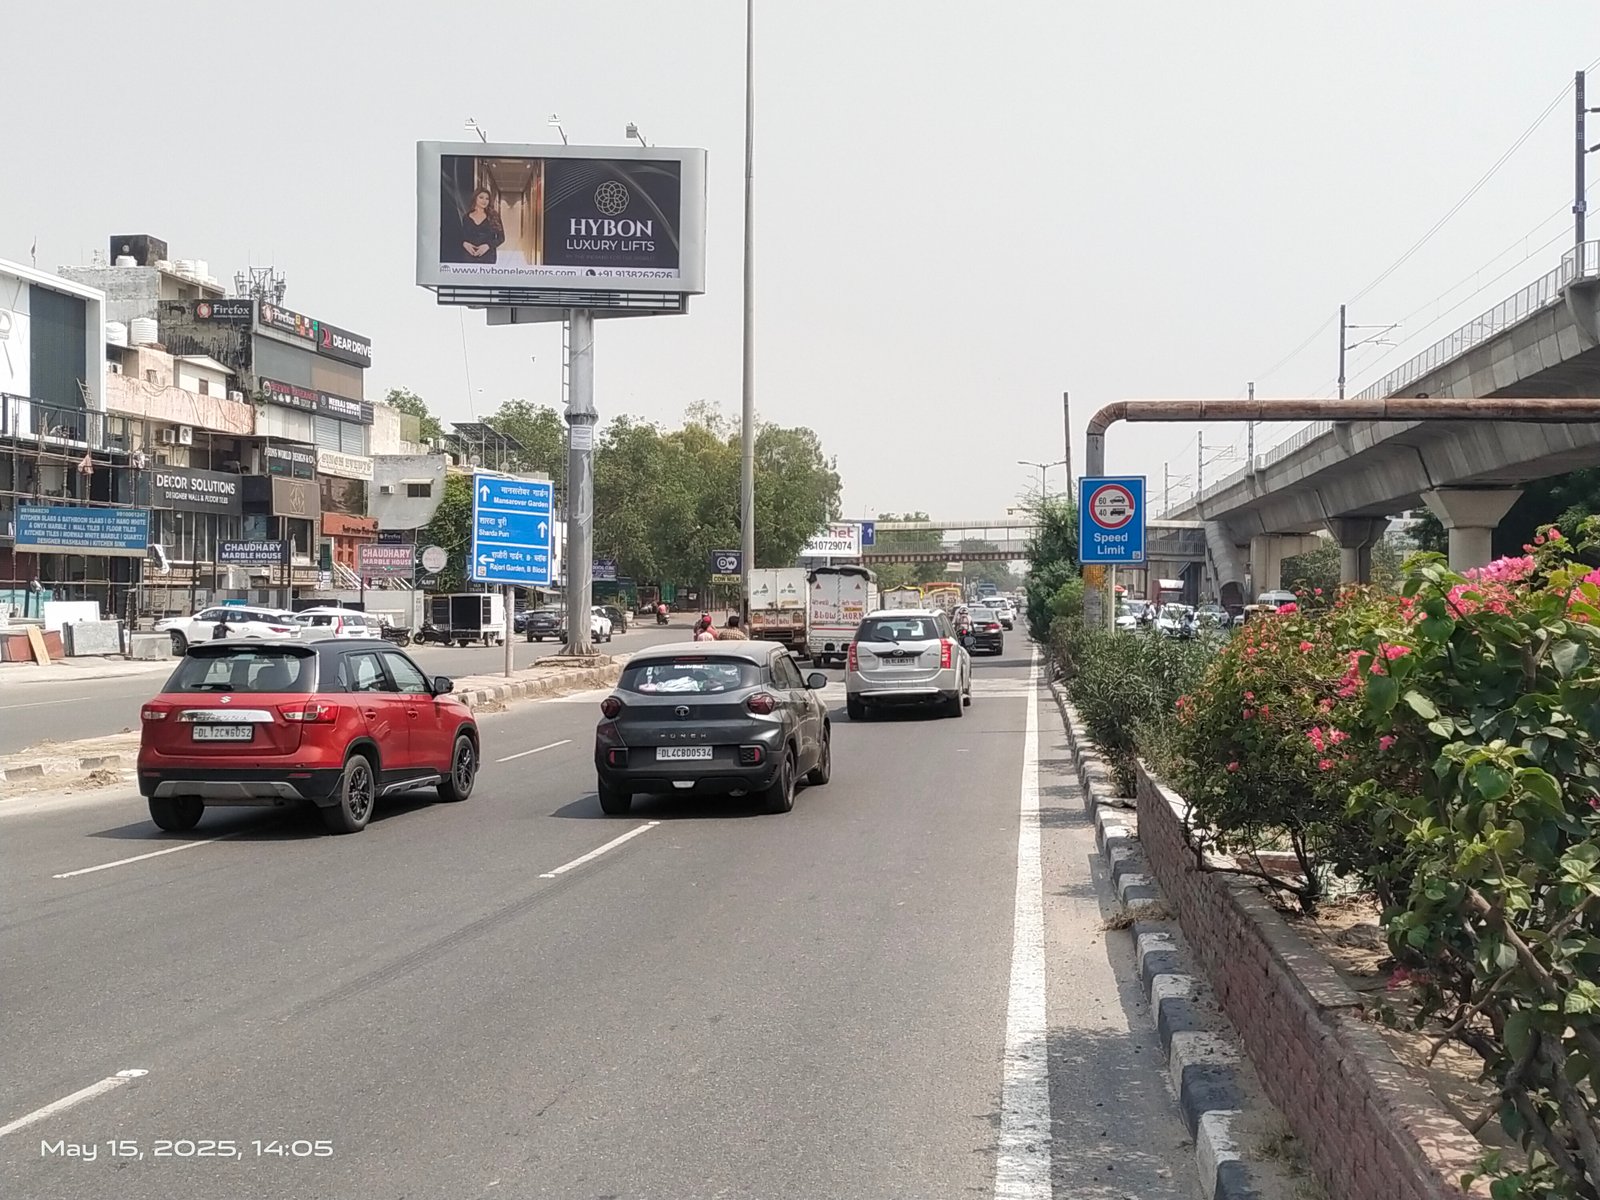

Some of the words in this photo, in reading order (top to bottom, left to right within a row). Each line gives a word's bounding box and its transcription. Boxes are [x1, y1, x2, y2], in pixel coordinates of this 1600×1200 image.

[570, 218, 653, 237] HYBON
[566, 239, 618, 250] LUXURY
[621, 240, 655, 252] LIFTS
[213, 304, 250, 315] Firefox
[332, 334, 352, 352] DEAR
[352, 341, 372, 358] DRIVE
[156, 474, 187, 490] DECOR
[191, 478, 236, 494] SOLUTIONS
[532, 488, 548, 498] गार्डन
[528, 500, 548, 508] Garden
[1098, 496, 1107, 505] 60
[1098, 508, 1107, 516] 40
[479, 517, 496, 526] शारदा
[498, 516, 508, 528] पुरी
[478, 529, 498, 537] Sharda
[498, 530, 510, 538] Puri
[1094, 532, 1128, 544] Speed
[224, 544, 282, 552] CHAUDHARY
[362, 548, 411, 558] CHAUDHARY
[1097, 544, 1125, 555] Limit
[532, 566, 547, 574] Block
[814, 610, 836, 619] BLOW
[842, 611, 864, 620] HORN
[661, 748, 712, 758] DL4CBD0534
